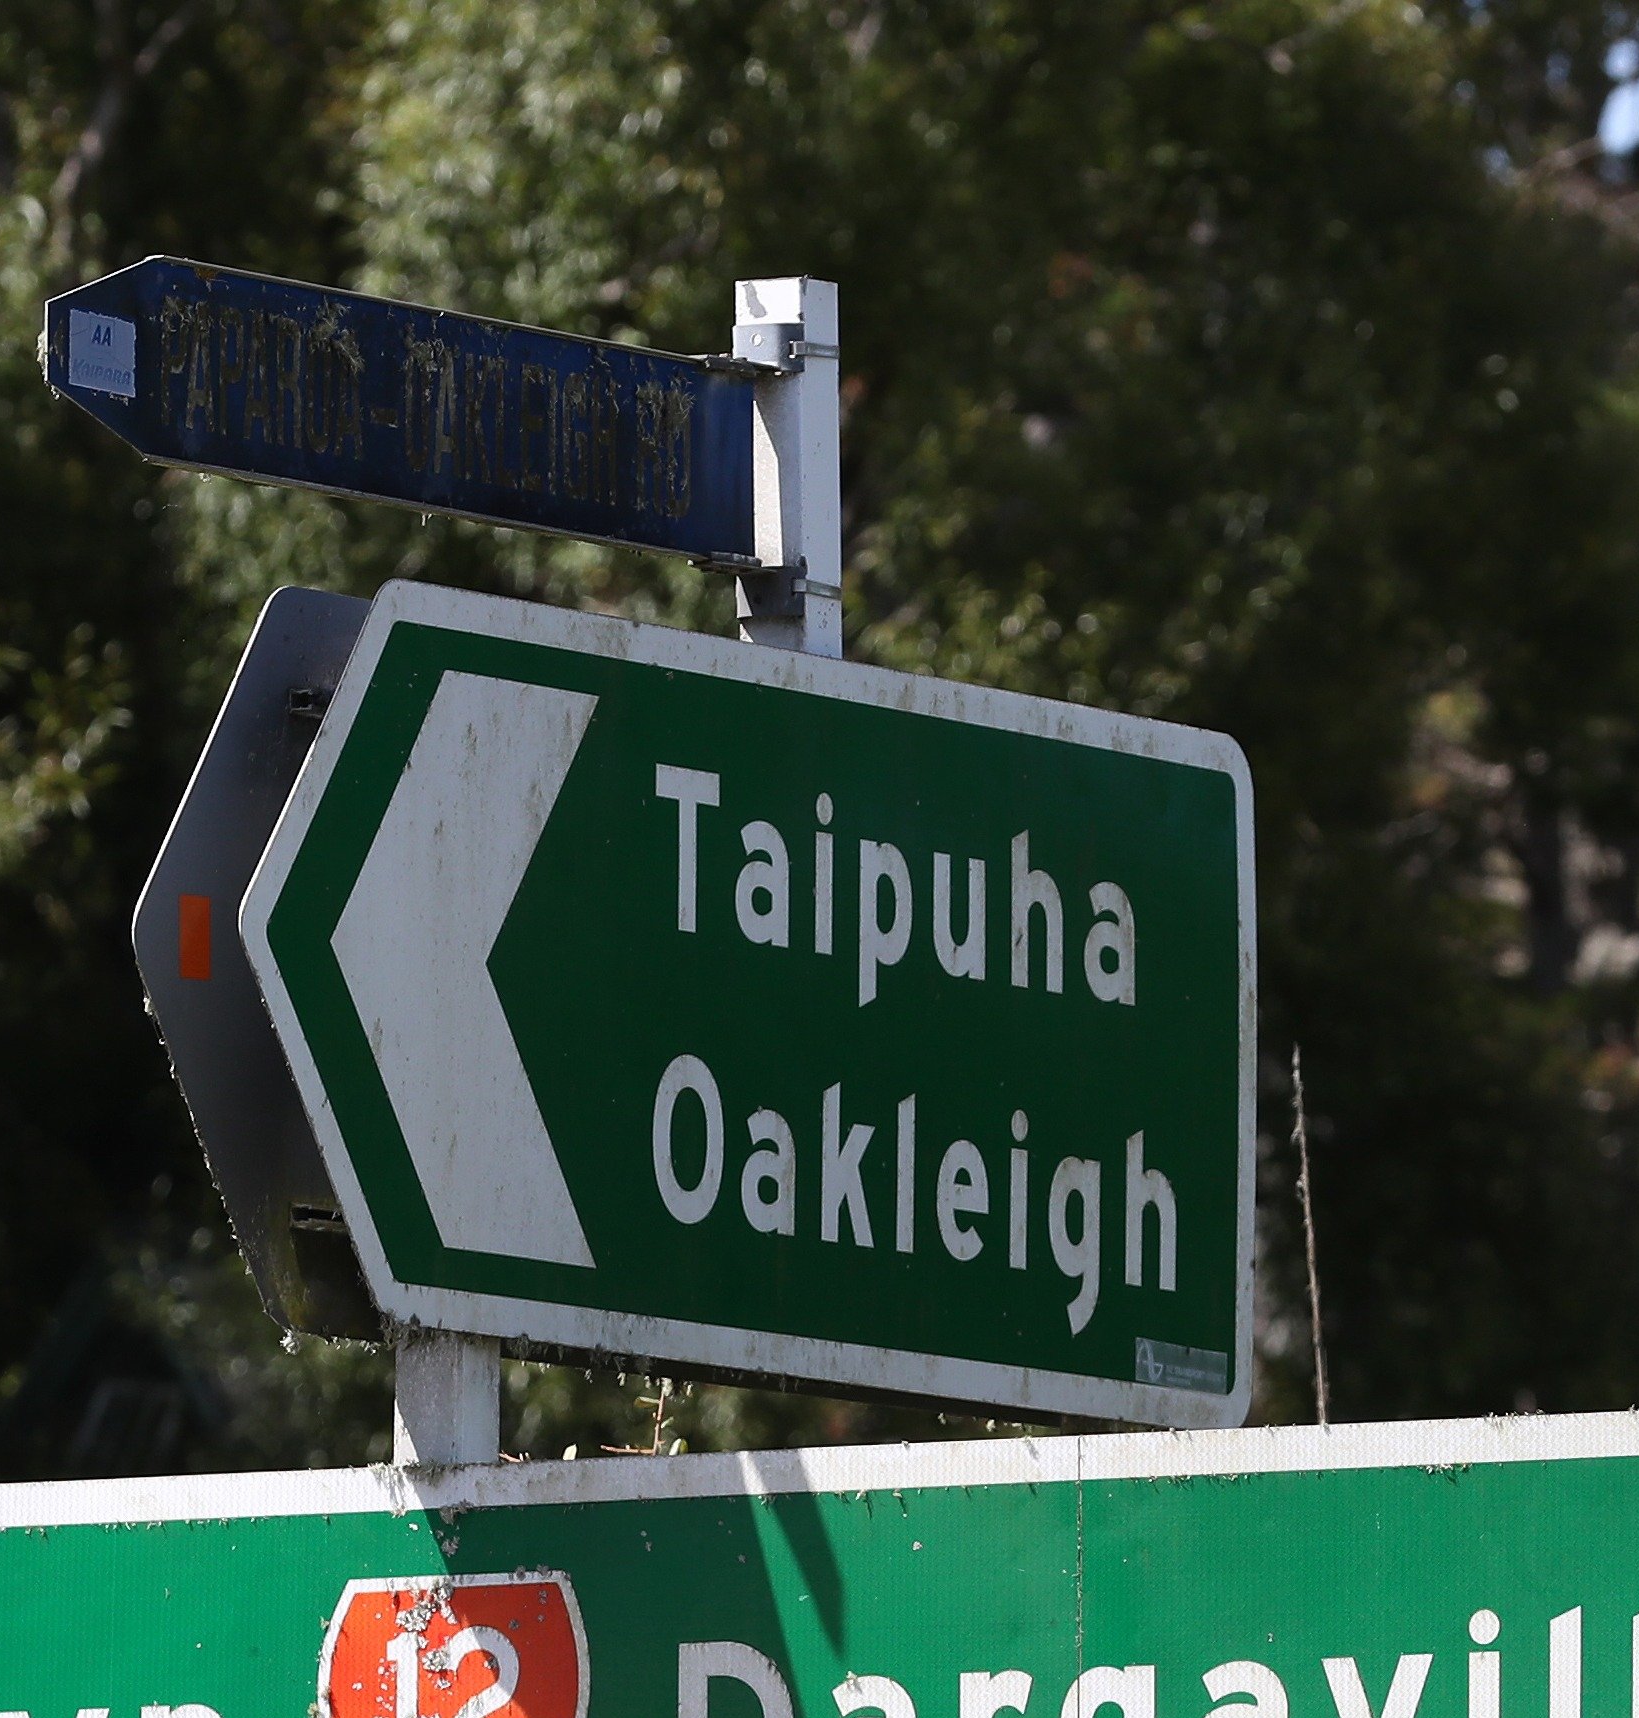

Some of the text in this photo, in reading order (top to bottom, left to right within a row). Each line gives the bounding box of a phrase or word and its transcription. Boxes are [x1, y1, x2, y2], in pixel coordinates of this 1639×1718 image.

[92, 324, 112, 347] AA
[656, 763, 1137, 1007] Taipuha
[652, 1052, 1180, 1336] Oakleigh
